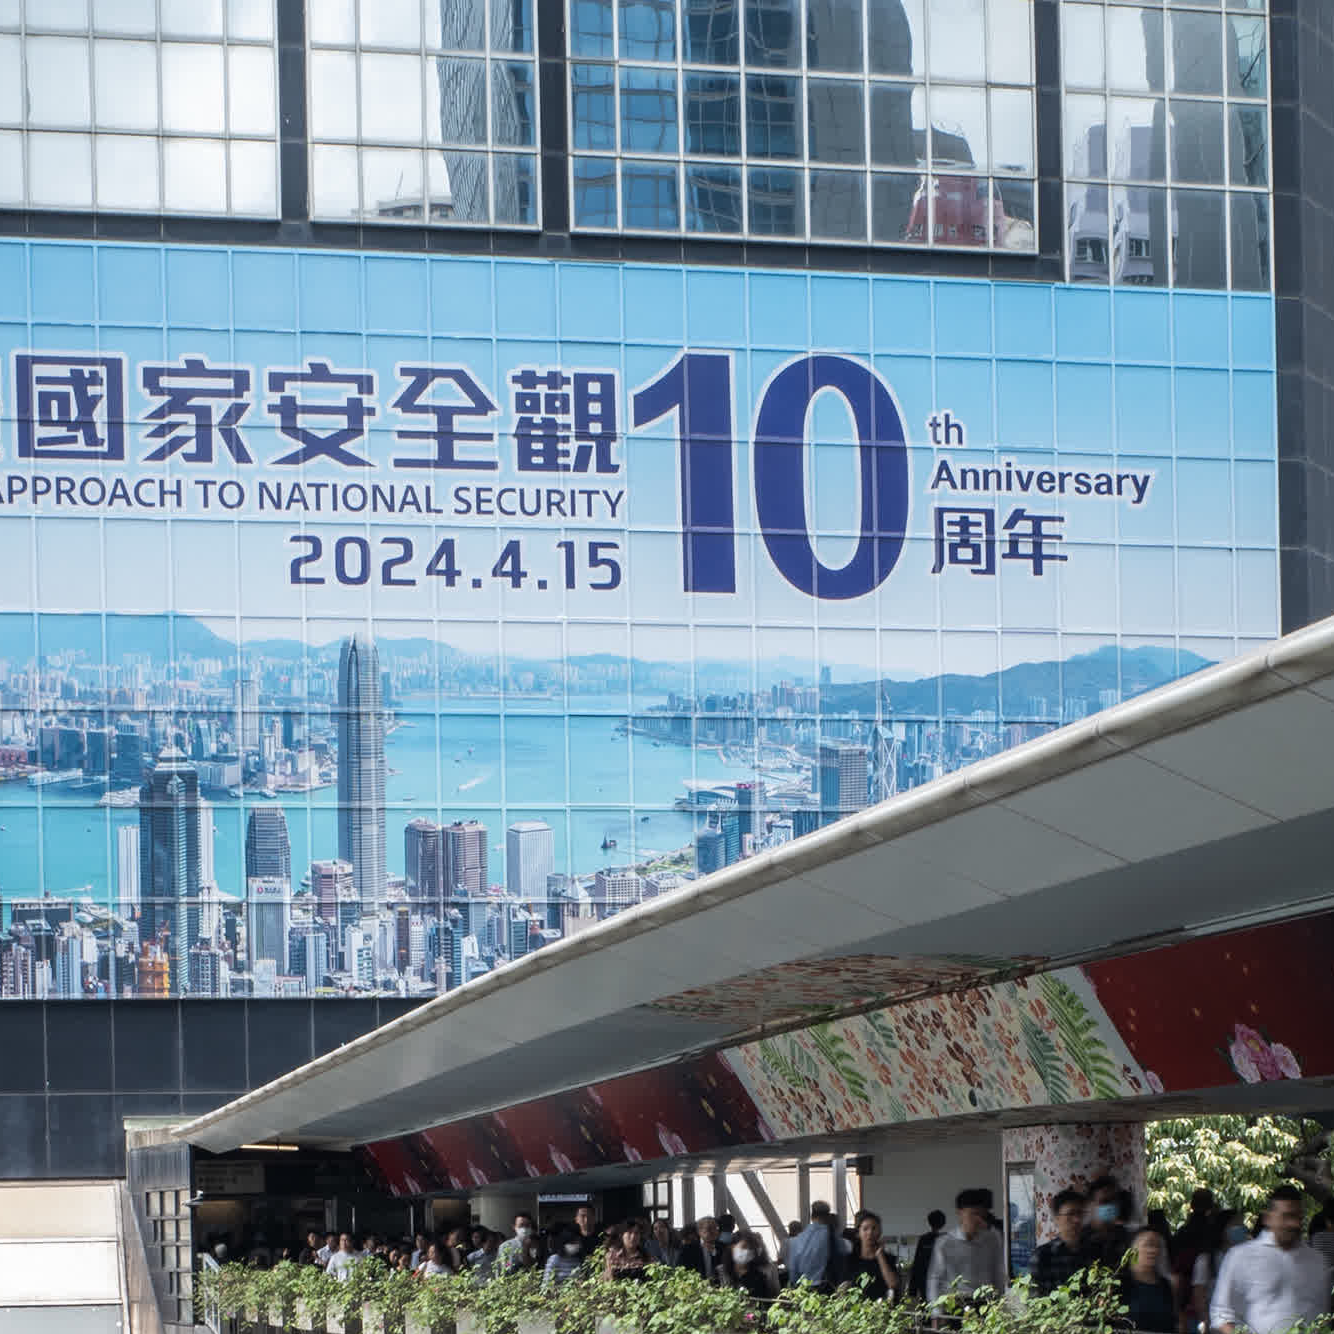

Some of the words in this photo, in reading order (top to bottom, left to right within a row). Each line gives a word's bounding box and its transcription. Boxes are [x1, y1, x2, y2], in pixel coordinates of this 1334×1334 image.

[929, 414, 964, 446] th
[194, 480, 245, 510] TO
[258, 481, 444, 514] NATIONAL
[453, 486, 625, 518] SECURITY
[632, 352, 910, 600] 10
[931, 460, 1151, 504] Anniversary
[289, 535, 622, 591] 2024.4.15
[931, 508, 1068, 577] 周年
